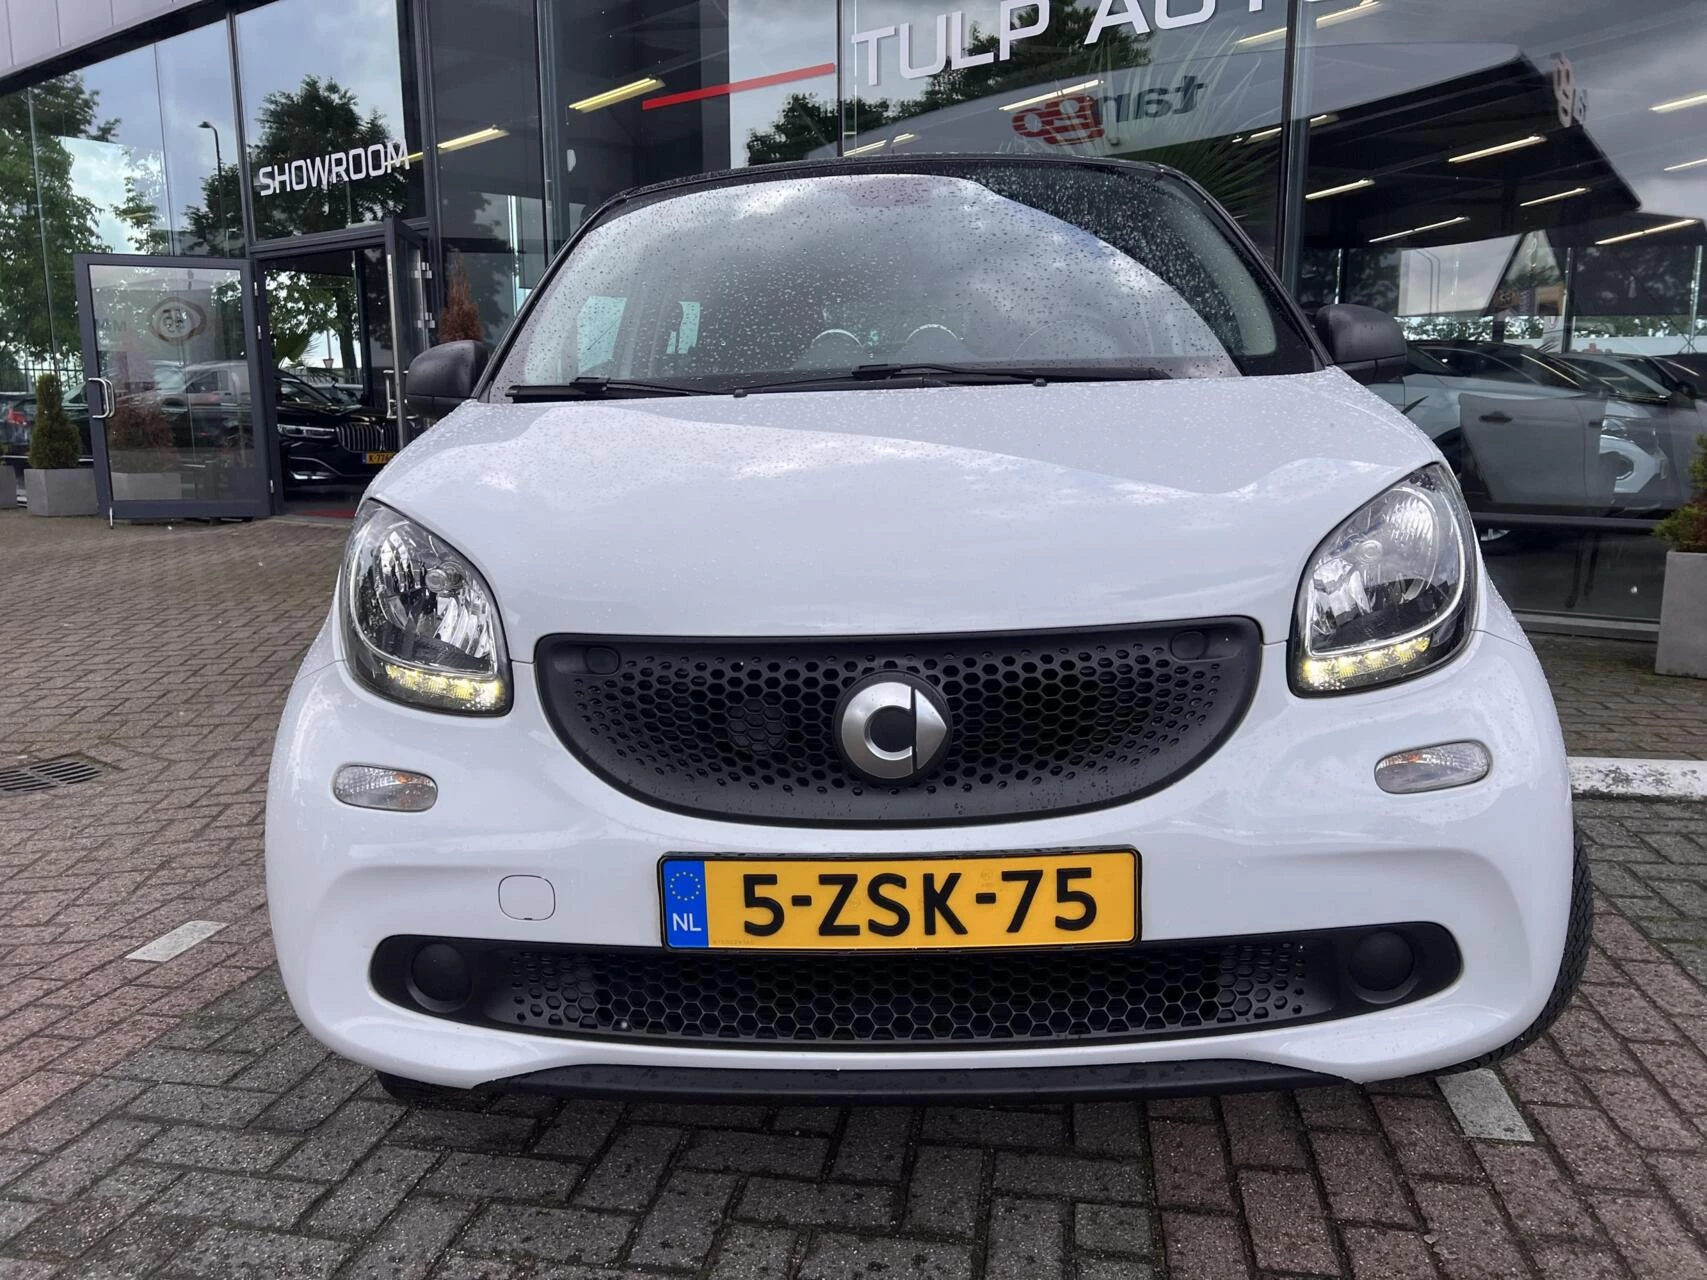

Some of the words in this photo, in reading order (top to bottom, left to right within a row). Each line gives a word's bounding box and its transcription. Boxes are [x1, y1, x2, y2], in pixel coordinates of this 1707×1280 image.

[851, 0, 1051, 87] TULP
[1084, 0, 1322, 45] AU
[258, 140, 411, 197] SHOWROOM
[672, 912, 702, 932] NL
[743, 867, 1098, 937] 5-ZSK-75
